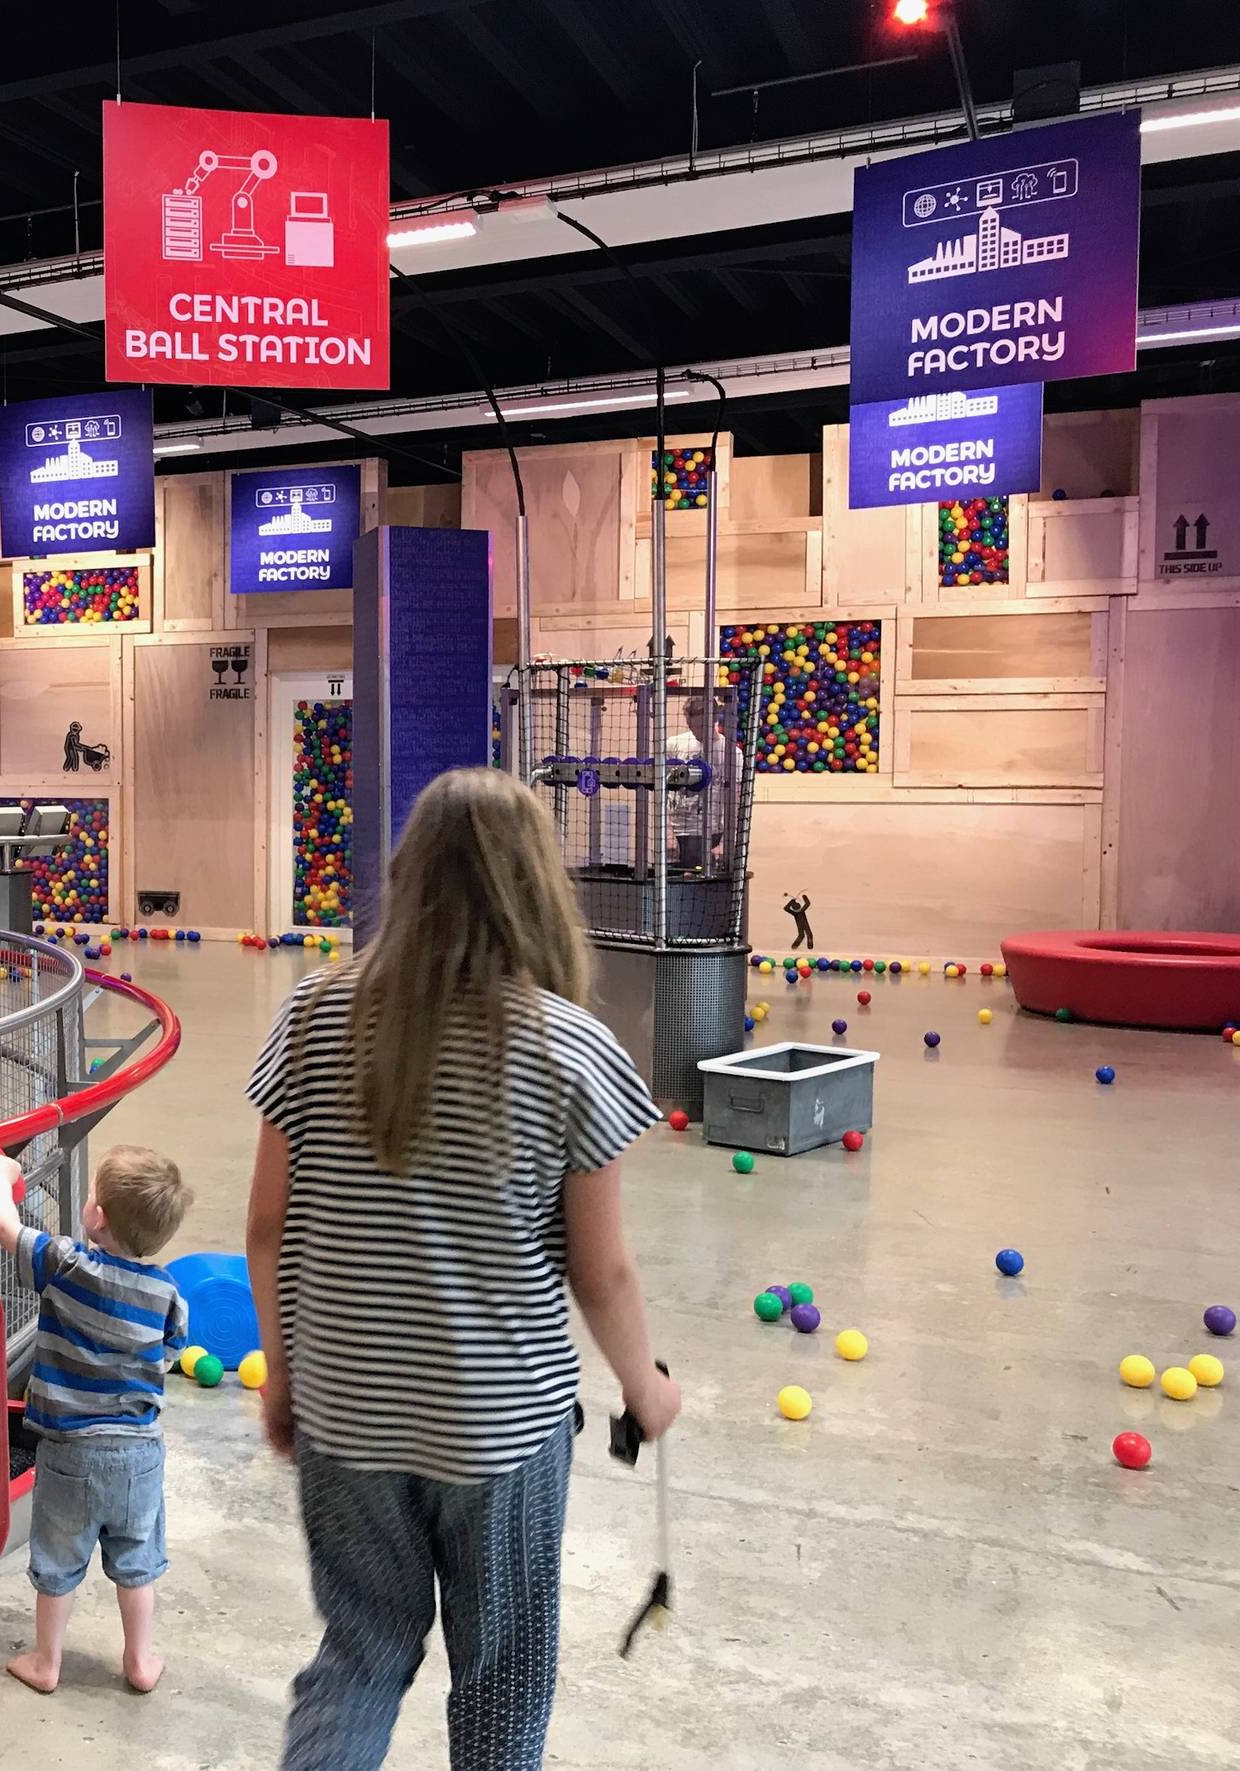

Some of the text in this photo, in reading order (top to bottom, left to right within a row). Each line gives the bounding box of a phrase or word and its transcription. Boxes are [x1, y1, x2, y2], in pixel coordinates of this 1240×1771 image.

[168, 292, 329, 327] CENTRAL
[911, 296, 1063, 344] MODERN
[125, 329, 371, 366] BALL STATION
[908, 331, 1065, 377] FACTORY
[890, 438, 994, 469] MODERN
[888, 462, 996, 492] FACTORY
[33, 498, 117, 521] MODERN
[33, 520, 119, 543] FACTORY
[260, 549, 330, 566] MODERN
[1159, 562, 1223, 575] THIS SIDE UP
[258, 565, 331, 582] FACTORY
[210, 646, 250, 658] FRAGILE
[210, 688, 250, 700] FRAGILE
